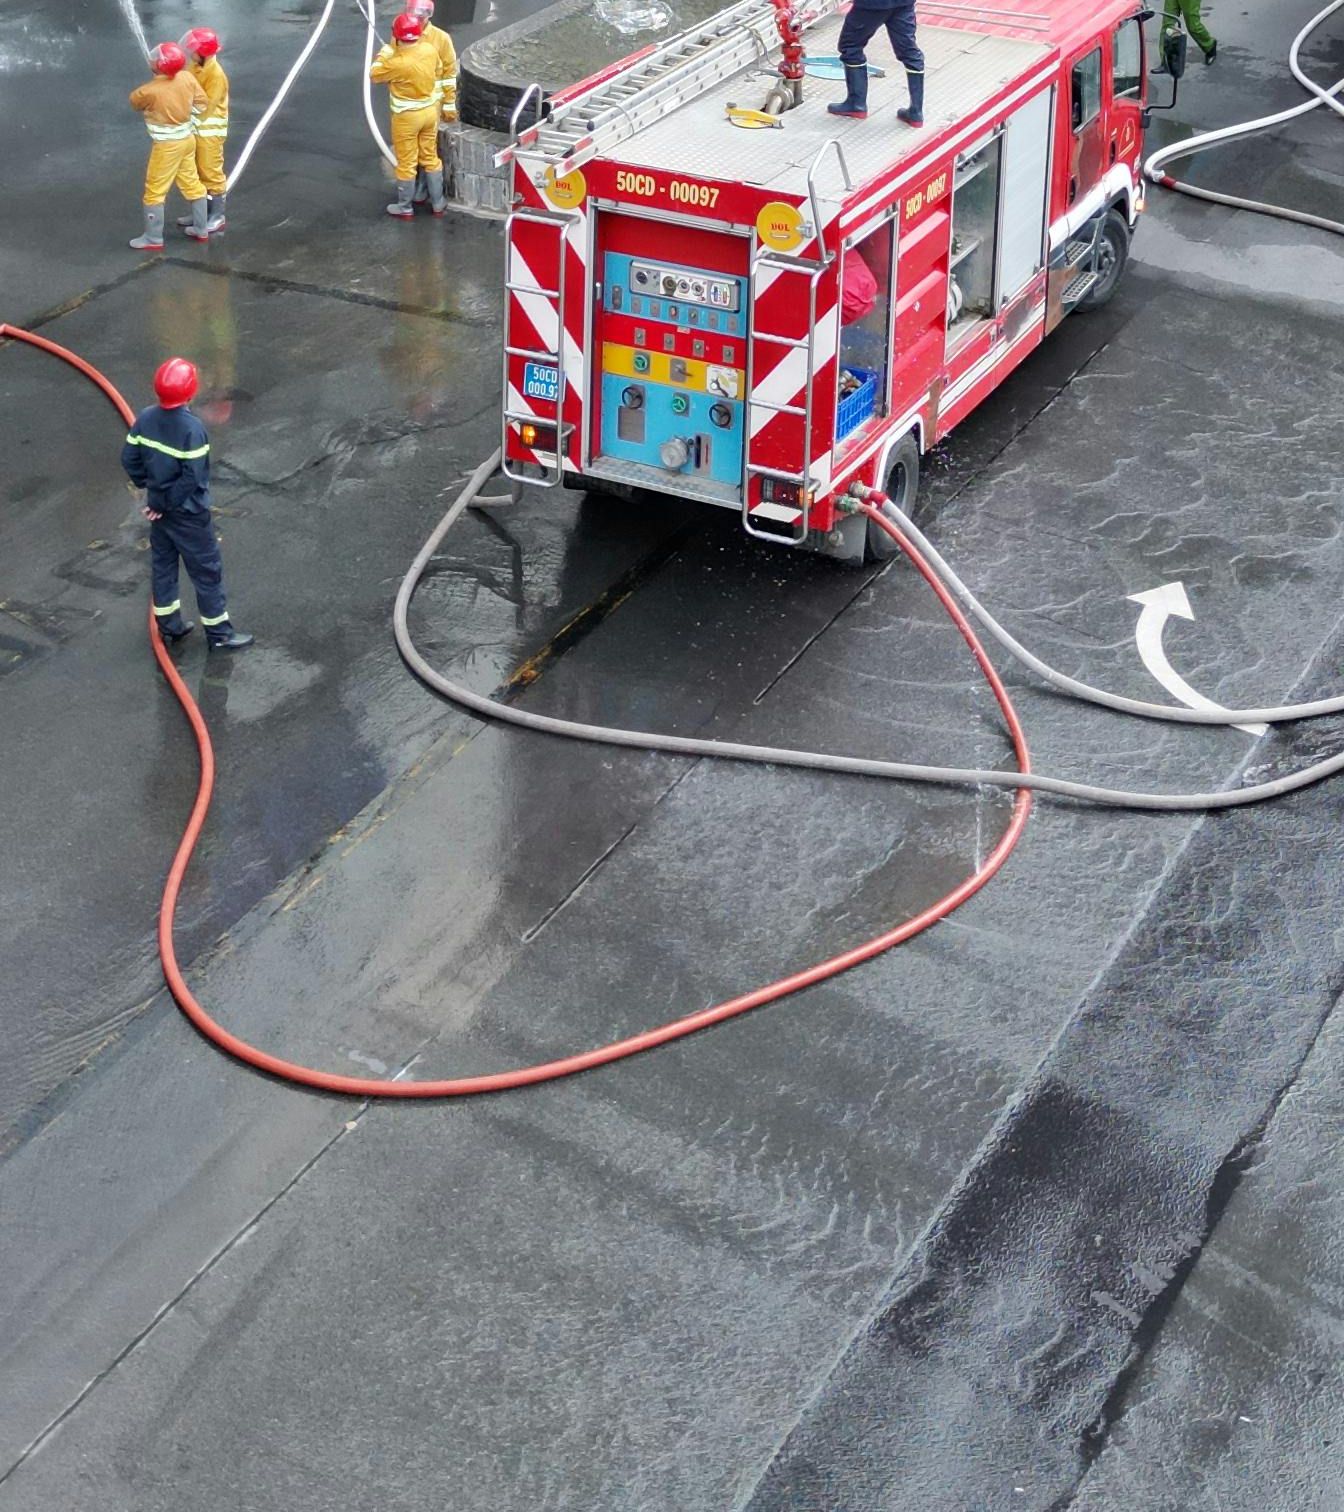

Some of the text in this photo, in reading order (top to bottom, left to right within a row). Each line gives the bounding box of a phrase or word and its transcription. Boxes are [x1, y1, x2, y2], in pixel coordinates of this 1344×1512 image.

[617, 171, 655, 196] 50CD
[669, 181, 720, 208] 00097
[533, 367, 557, 384] 50CD
